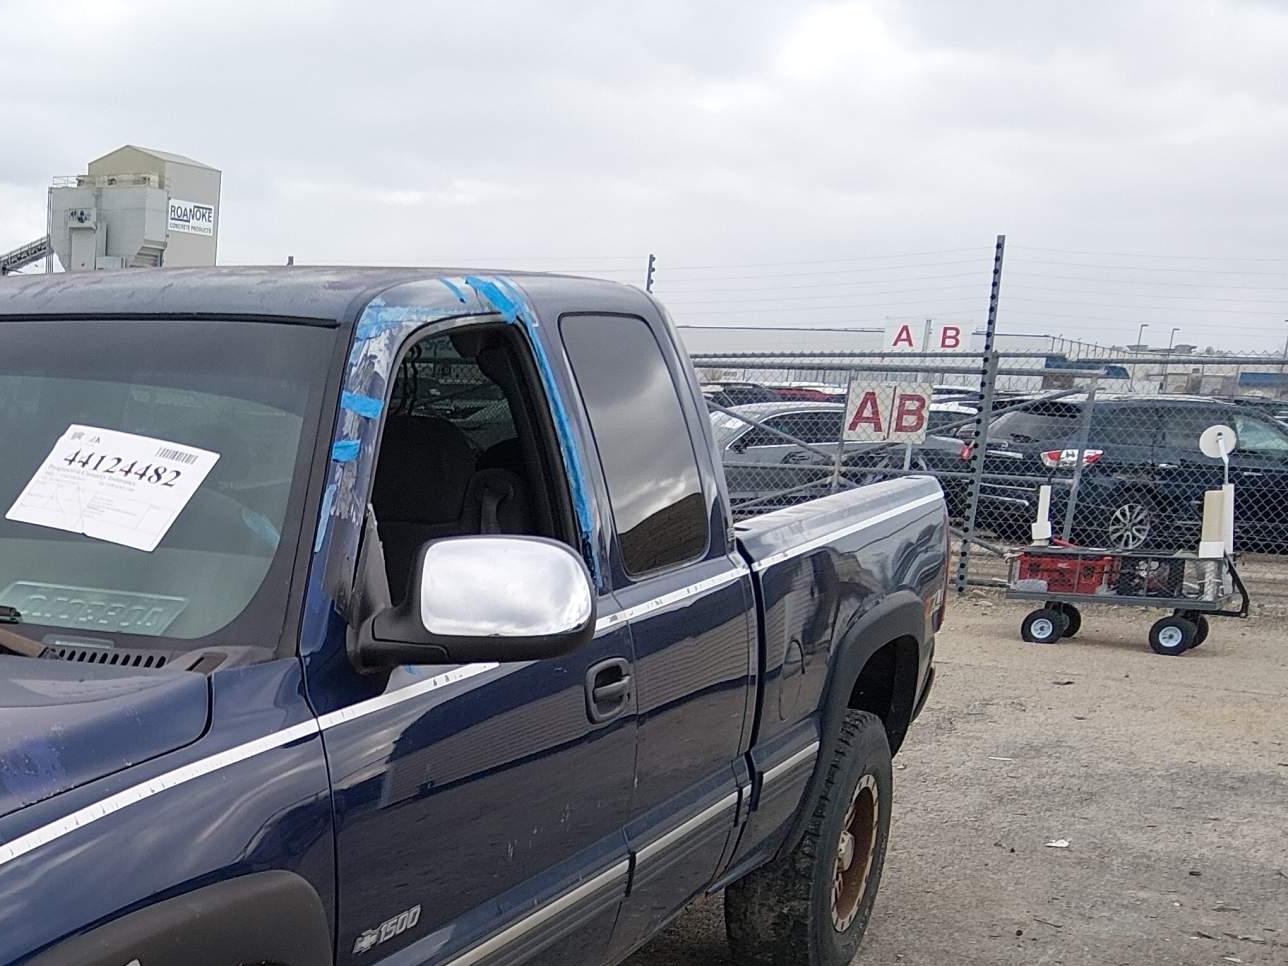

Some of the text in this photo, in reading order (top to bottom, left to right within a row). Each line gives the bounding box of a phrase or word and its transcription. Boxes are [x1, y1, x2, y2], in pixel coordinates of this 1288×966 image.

[170, 205, 212, 222] ROANOKE
[892, 324, 961, 348] A B
[848, 391, 926, 433] A B
[63, 449, 182, 487] 44124482
[376, 903, 422, 946] 1500
